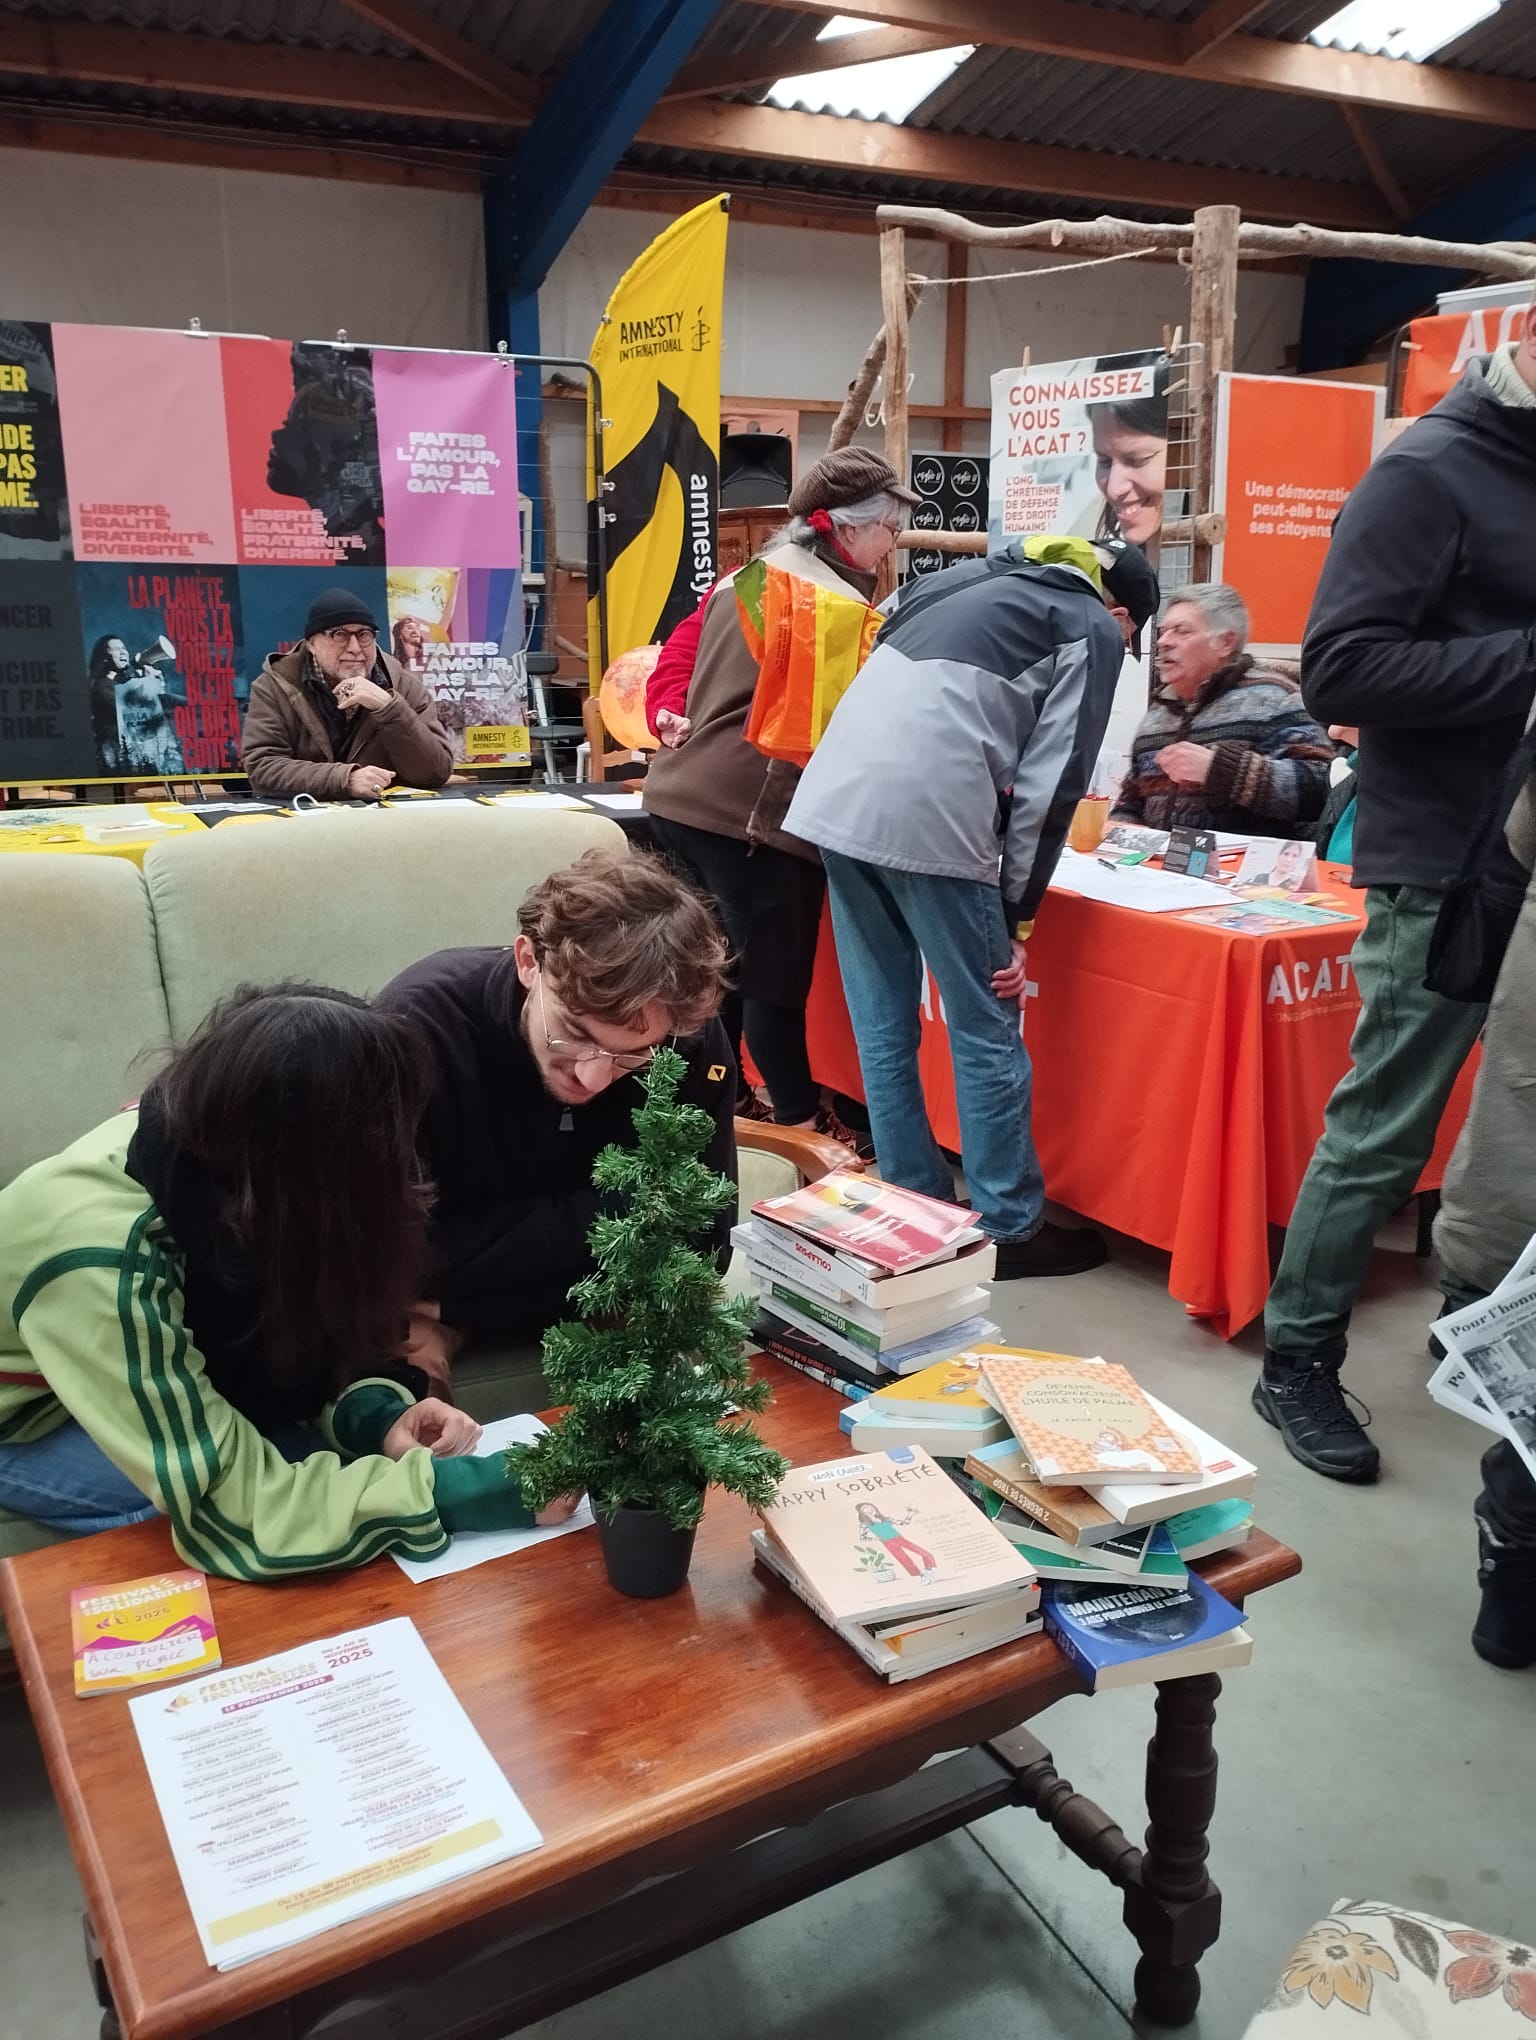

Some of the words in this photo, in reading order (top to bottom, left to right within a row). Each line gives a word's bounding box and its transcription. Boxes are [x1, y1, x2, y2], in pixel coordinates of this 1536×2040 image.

[620, 310, 684, 345] AMNESTY
[620, 337, 684, 363] INTERNATIONAL
[1009, 371, 1150, 406] CONNAISSEZ-
[1009, 408, 1060, 431] VOUS
[409, 432, 486, 447] FAITES
[1008, 432, 1070, 458] L'ACAT
[1077, 432, 1086, 453] ?
[397, 446, 500, 467] L'AMOUR,
[410, 463, 453, 478] PAS
[460, 464, 489, 480] LA
[407, 479, 495, 495] GAY-RE.
[1245, 481, 1273, 497] Une
[79, 503, 170, 518] LIBERTÉ,
[1006, 501, 1018, 509] DE
[1253, 503, 1312, 518] peut-elle
[241, 508, 328, 525] LIBERTÉ,
[1006, 512, 1023, 521] DES
[1026, 510, 1057, 520] DROITS
[1005, 521, 1046, 533] HUMAINS
[1250, 521, 1273, 534] ses
[83, 530, 213, 546] FRATERNITÉ,
[244, 534, 367, 551] FRATERNITÉ,
[128, 576, 150, 608] LA
[165, 608, 210, 640] VOUS
[212, 604, 235, 641] LA
[175, 640, 235, 673] VOULEZ
[422, 641, 498, 656] FAITES
[185, 668, 236, 704] BLEUE
[423, 673, 465, 686] PAS
[472, 673, 501, 686] LA
[200, 704, 240, 737] BIEN
[472, 733, 506, 742] AMNESTY
[1266, 955, 1352, 1005] ACAT
[795, 1242, 832, 1272] COLLAPSUS
[1450, 1314, 1487, 1337] Pour
[813, 1472, 834, 1481] MON
[837, 1465, 866, 1476] CAHIER
[992, 1478, 1010, 1494] TROP
[1010, 1488, 1020, 1500] DE
[1018, 1494, 1043, 1516] DEGRÉS
[1043, 1512, 1050, 1521] 2
[1066, 1588, 1173, 1616] MAINTENANT
[1102, 1609, 1126, 1620] POUR
[1123, 1603, 1156, 1616] SAUVER
[1153, 1600, 1166, 1609] LE
[326, 1647, 375, 1668] 2025
[198, 1666, 275, 1694] FESTIVAL
[238, 1685, 299, 1707] PROGRAMME
